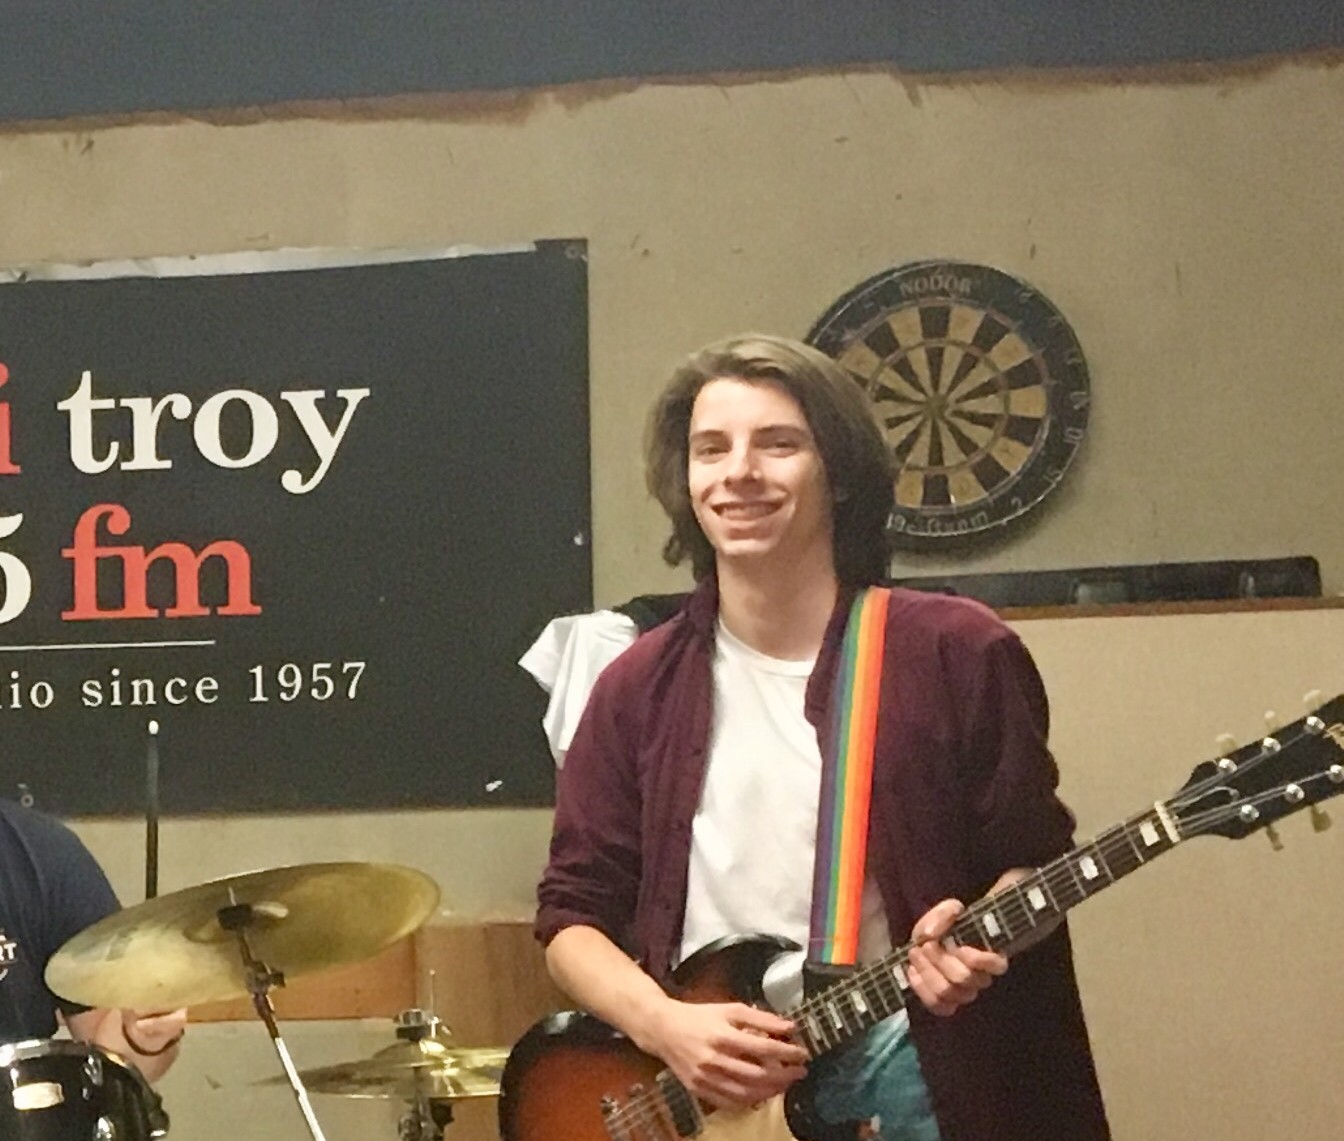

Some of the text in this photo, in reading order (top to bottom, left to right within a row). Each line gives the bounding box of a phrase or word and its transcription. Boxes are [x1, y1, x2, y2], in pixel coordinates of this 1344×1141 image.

[56, 369, 371, 495] troy
[61, 503, 263, 622] fm
[81, 667, 219, 707] since
[248, 660, 367, 702] 1957
